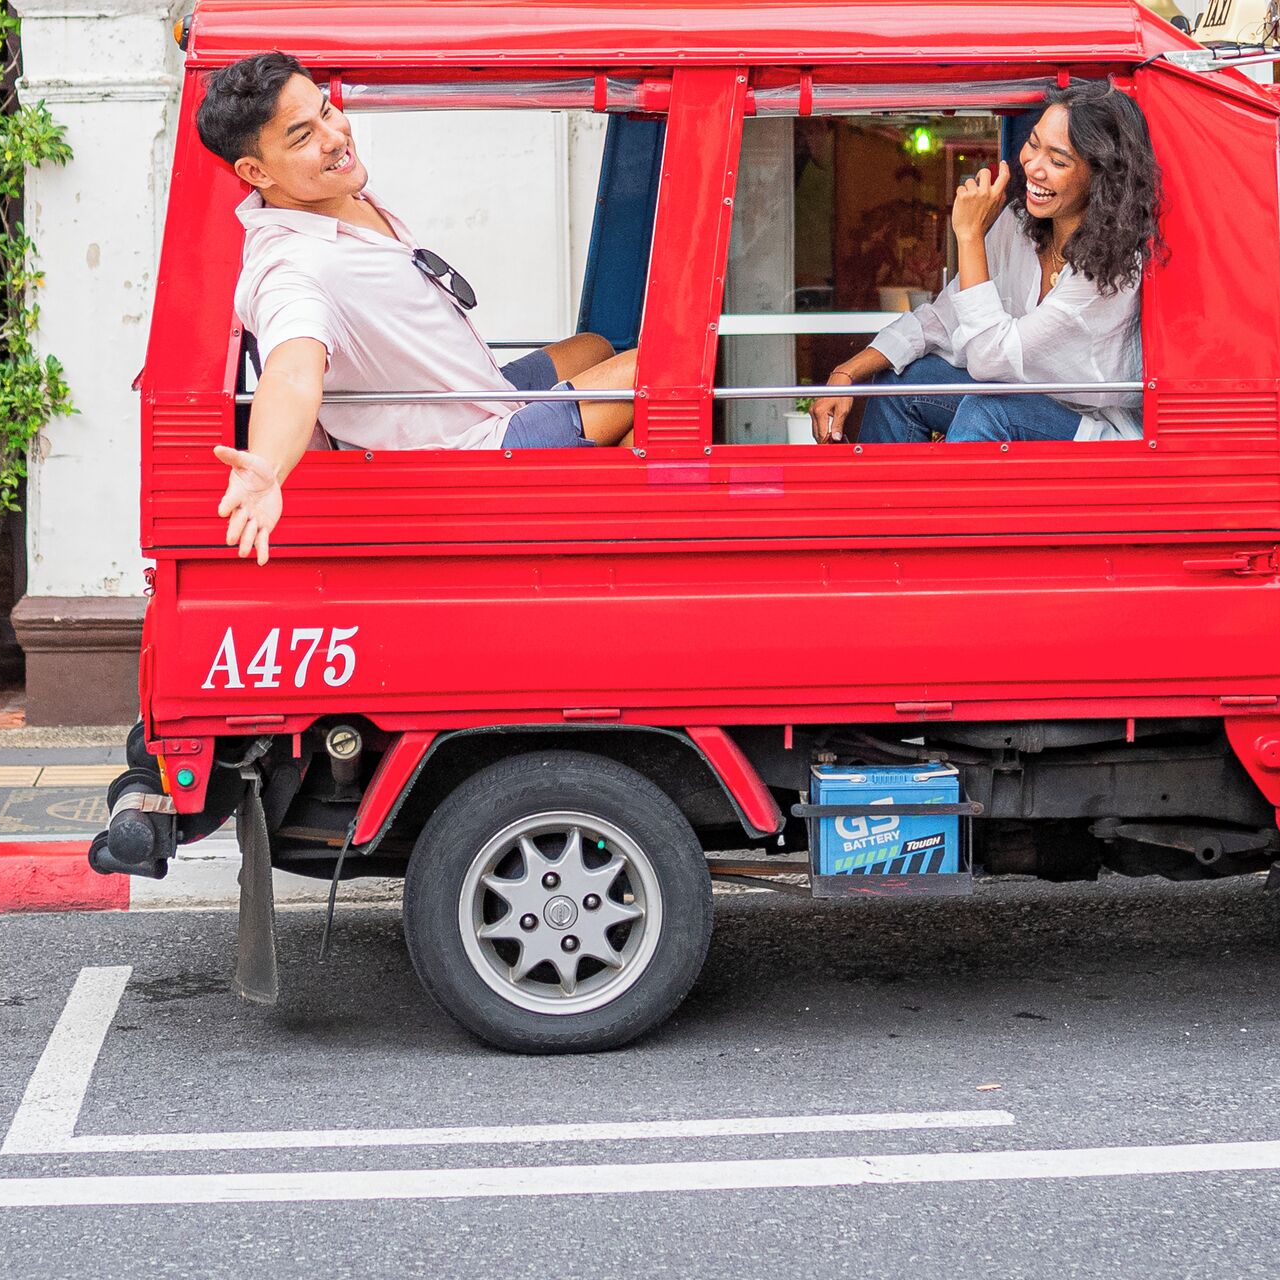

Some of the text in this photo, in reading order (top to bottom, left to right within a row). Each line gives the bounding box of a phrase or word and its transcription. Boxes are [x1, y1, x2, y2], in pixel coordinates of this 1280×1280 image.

[200, 625, 359, 689] A475
[834, 796, 900, 840] GS
[843, 830, 901, 852] BATTERY
[906, 836, 941, 852] TOUGH
